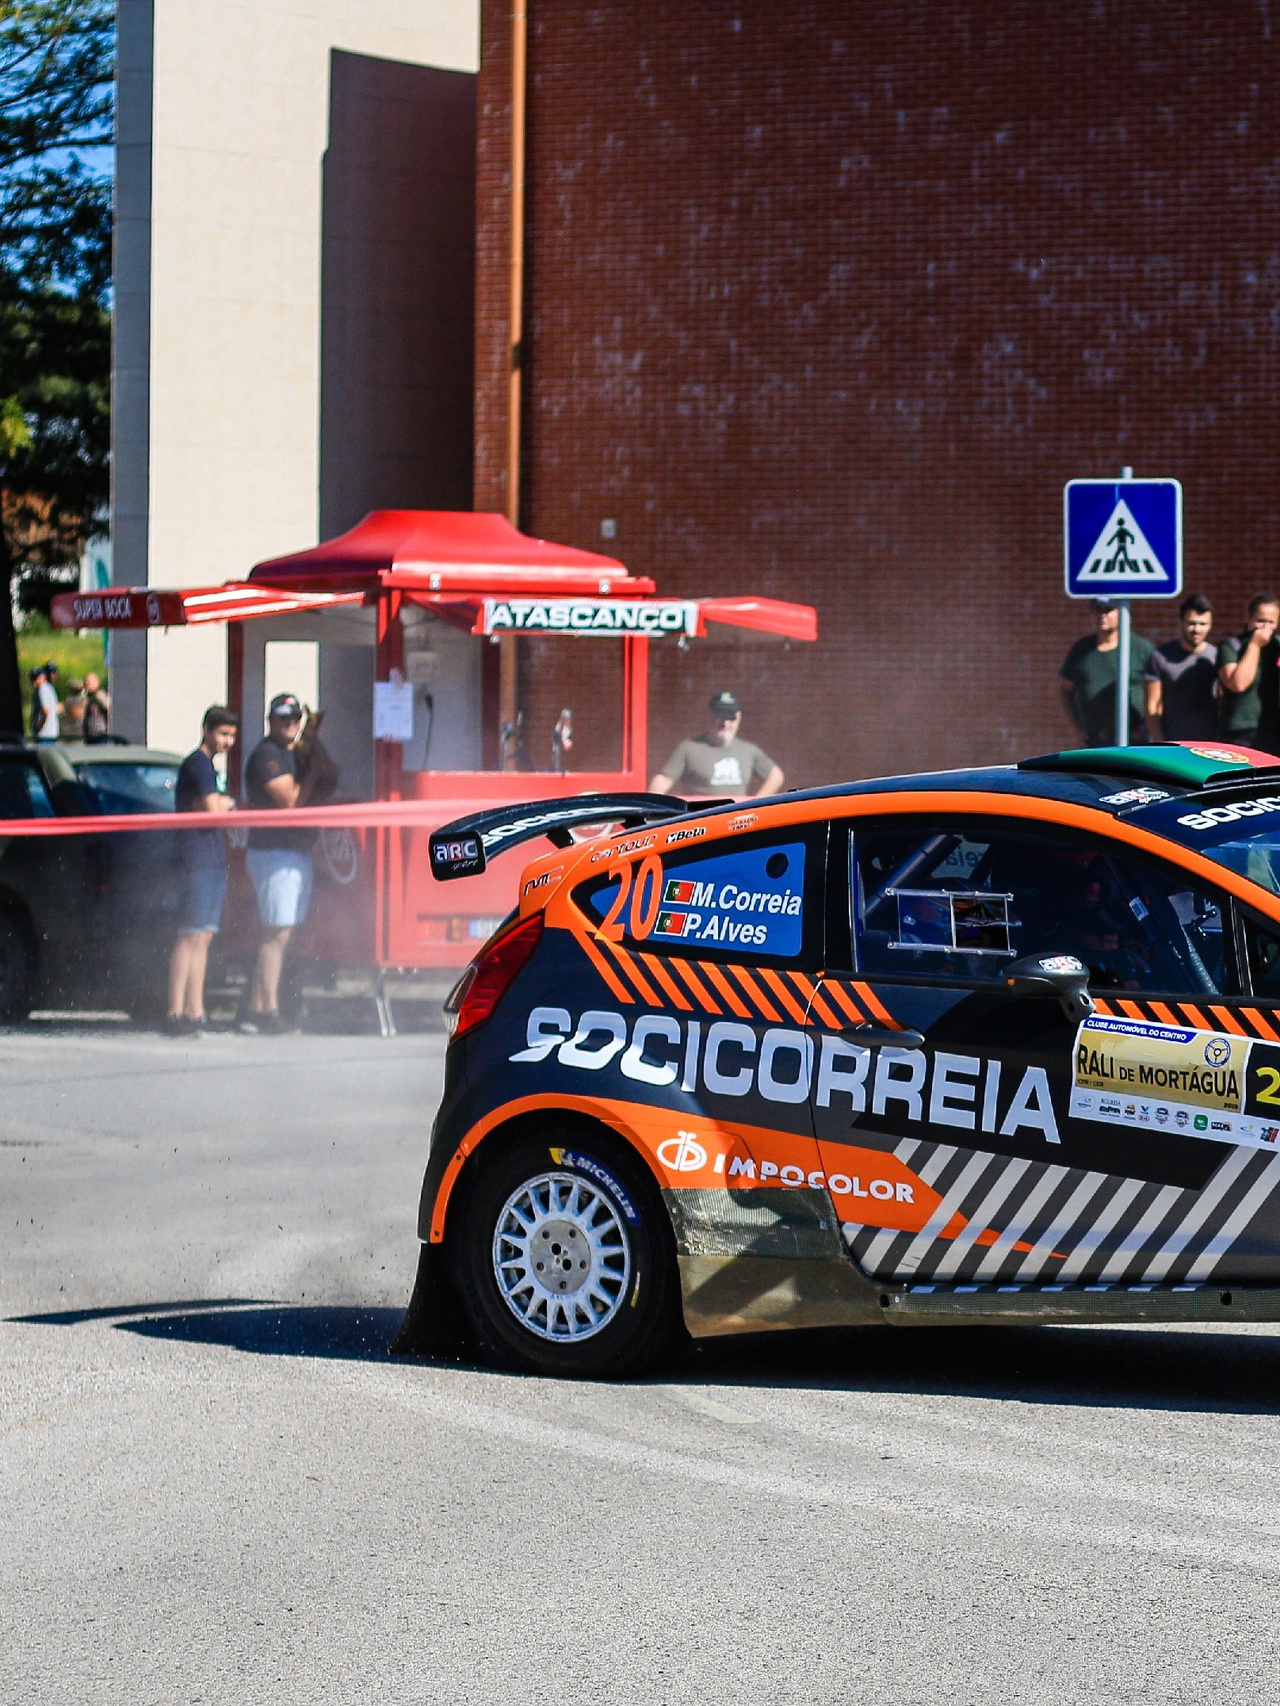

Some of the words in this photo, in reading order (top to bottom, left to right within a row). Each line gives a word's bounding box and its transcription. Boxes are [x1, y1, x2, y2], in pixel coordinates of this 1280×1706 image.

[73, 598, 103, 621] SUPER
[491, 604, 686, 632] ATASCANÇO
[677, 827, 705, 841] Beta
[594, 852, 664, 941] 20
[691, 882, 802, 916] M.Correia
[683, 913, 767, 944] P.Alves
[1087, 1020, 1108, 1030] CLUBE
[1109, 1023, 1147, 1035] AUTOMÓVEL
[1149, 1029, 1159, 1037] DO
[1160, 1031, 1186, 1041] CENTRO
[508, 1006, 1061, 1144] SOCICORREIA
[1078, 1043, 1114, 1079] RALI
[1139, 1065, 1240, 1099] MORTÁGUA
[576, 1157, 636, 1219] MICHELIN
[713, 1153, 914, 1204] IMPOCOLOR
